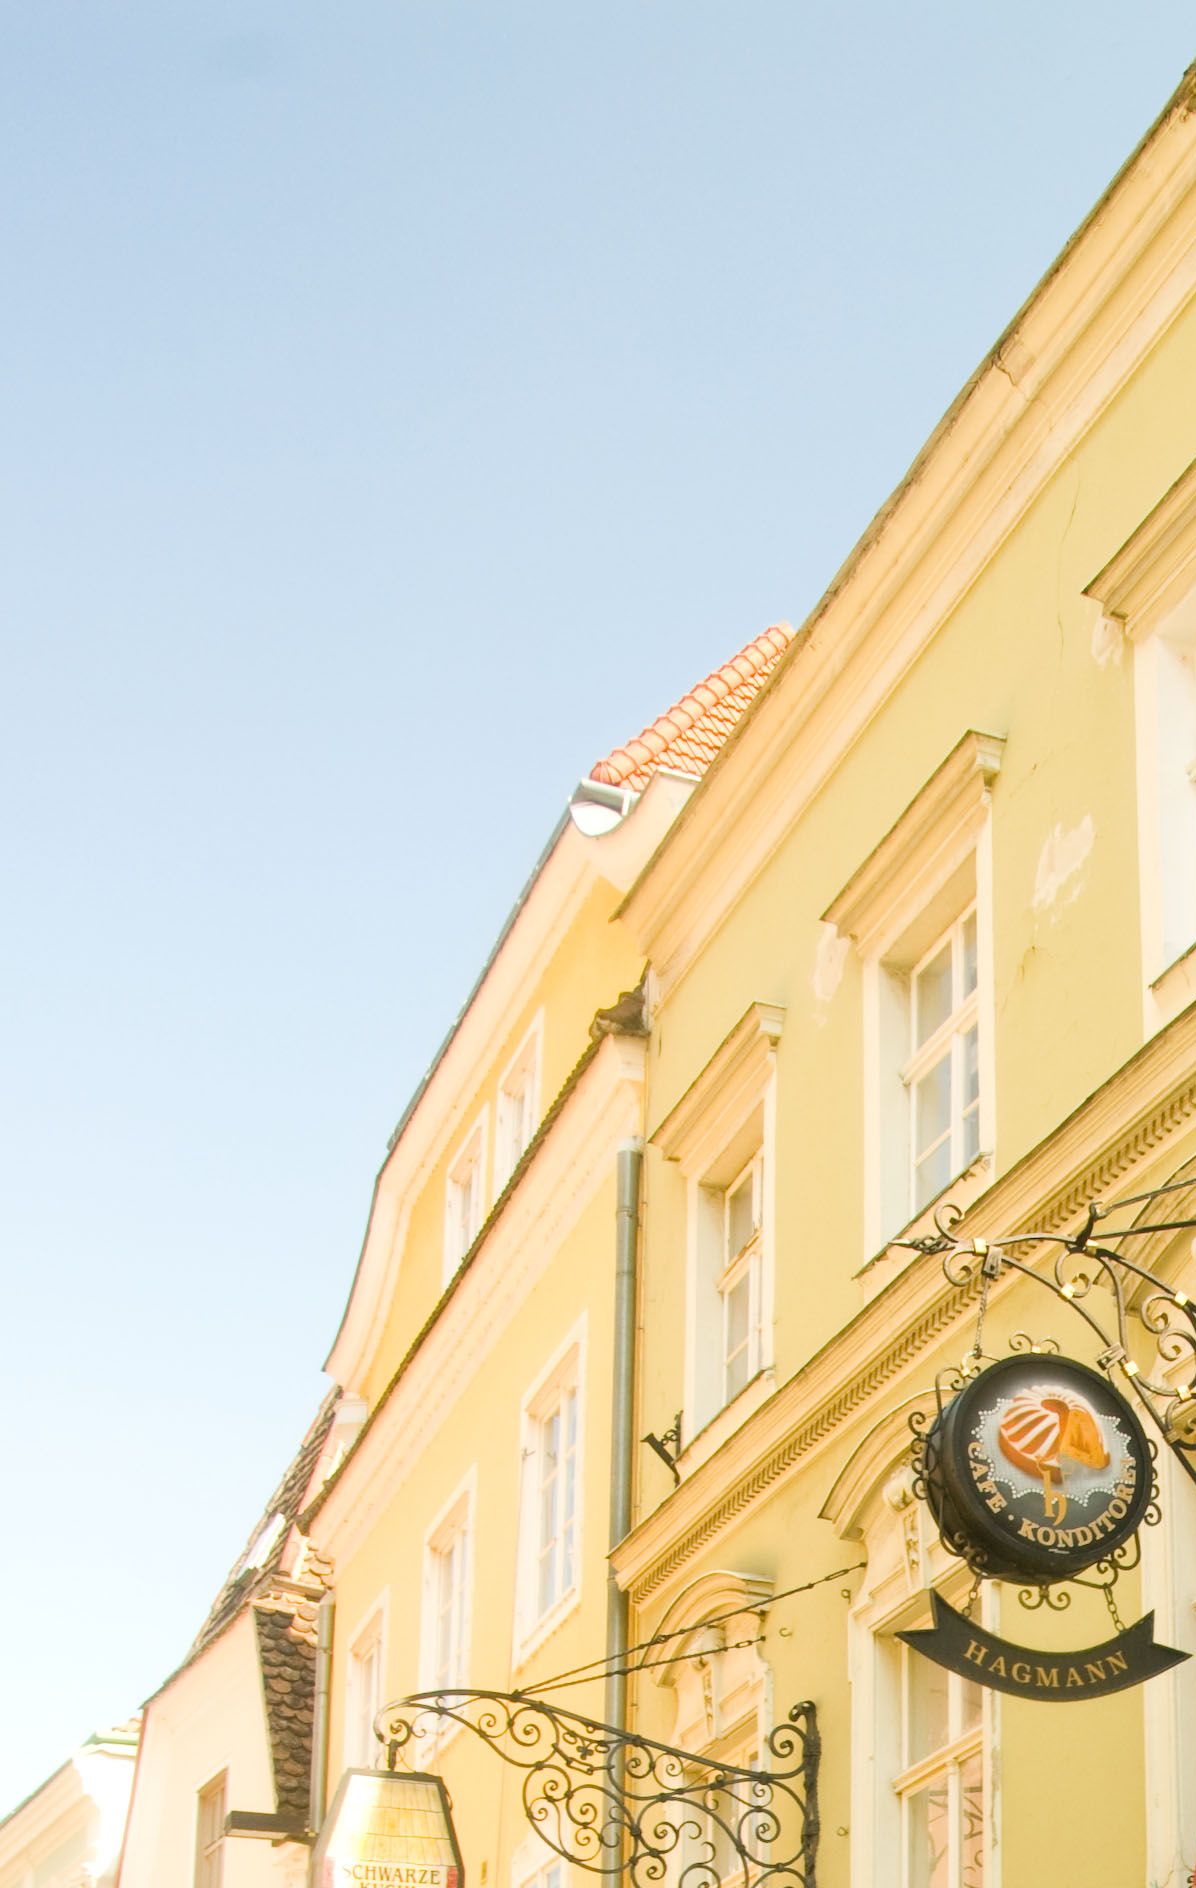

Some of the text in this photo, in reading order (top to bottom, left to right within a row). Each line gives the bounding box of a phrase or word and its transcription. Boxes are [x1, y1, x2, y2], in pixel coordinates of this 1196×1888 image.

[1018, 1457, 1137, 1549] KONDITOREI
[962, 1638, 1130, 1689] HAGMANN
[342, 1863, 441, 1886] SCHWARZE
